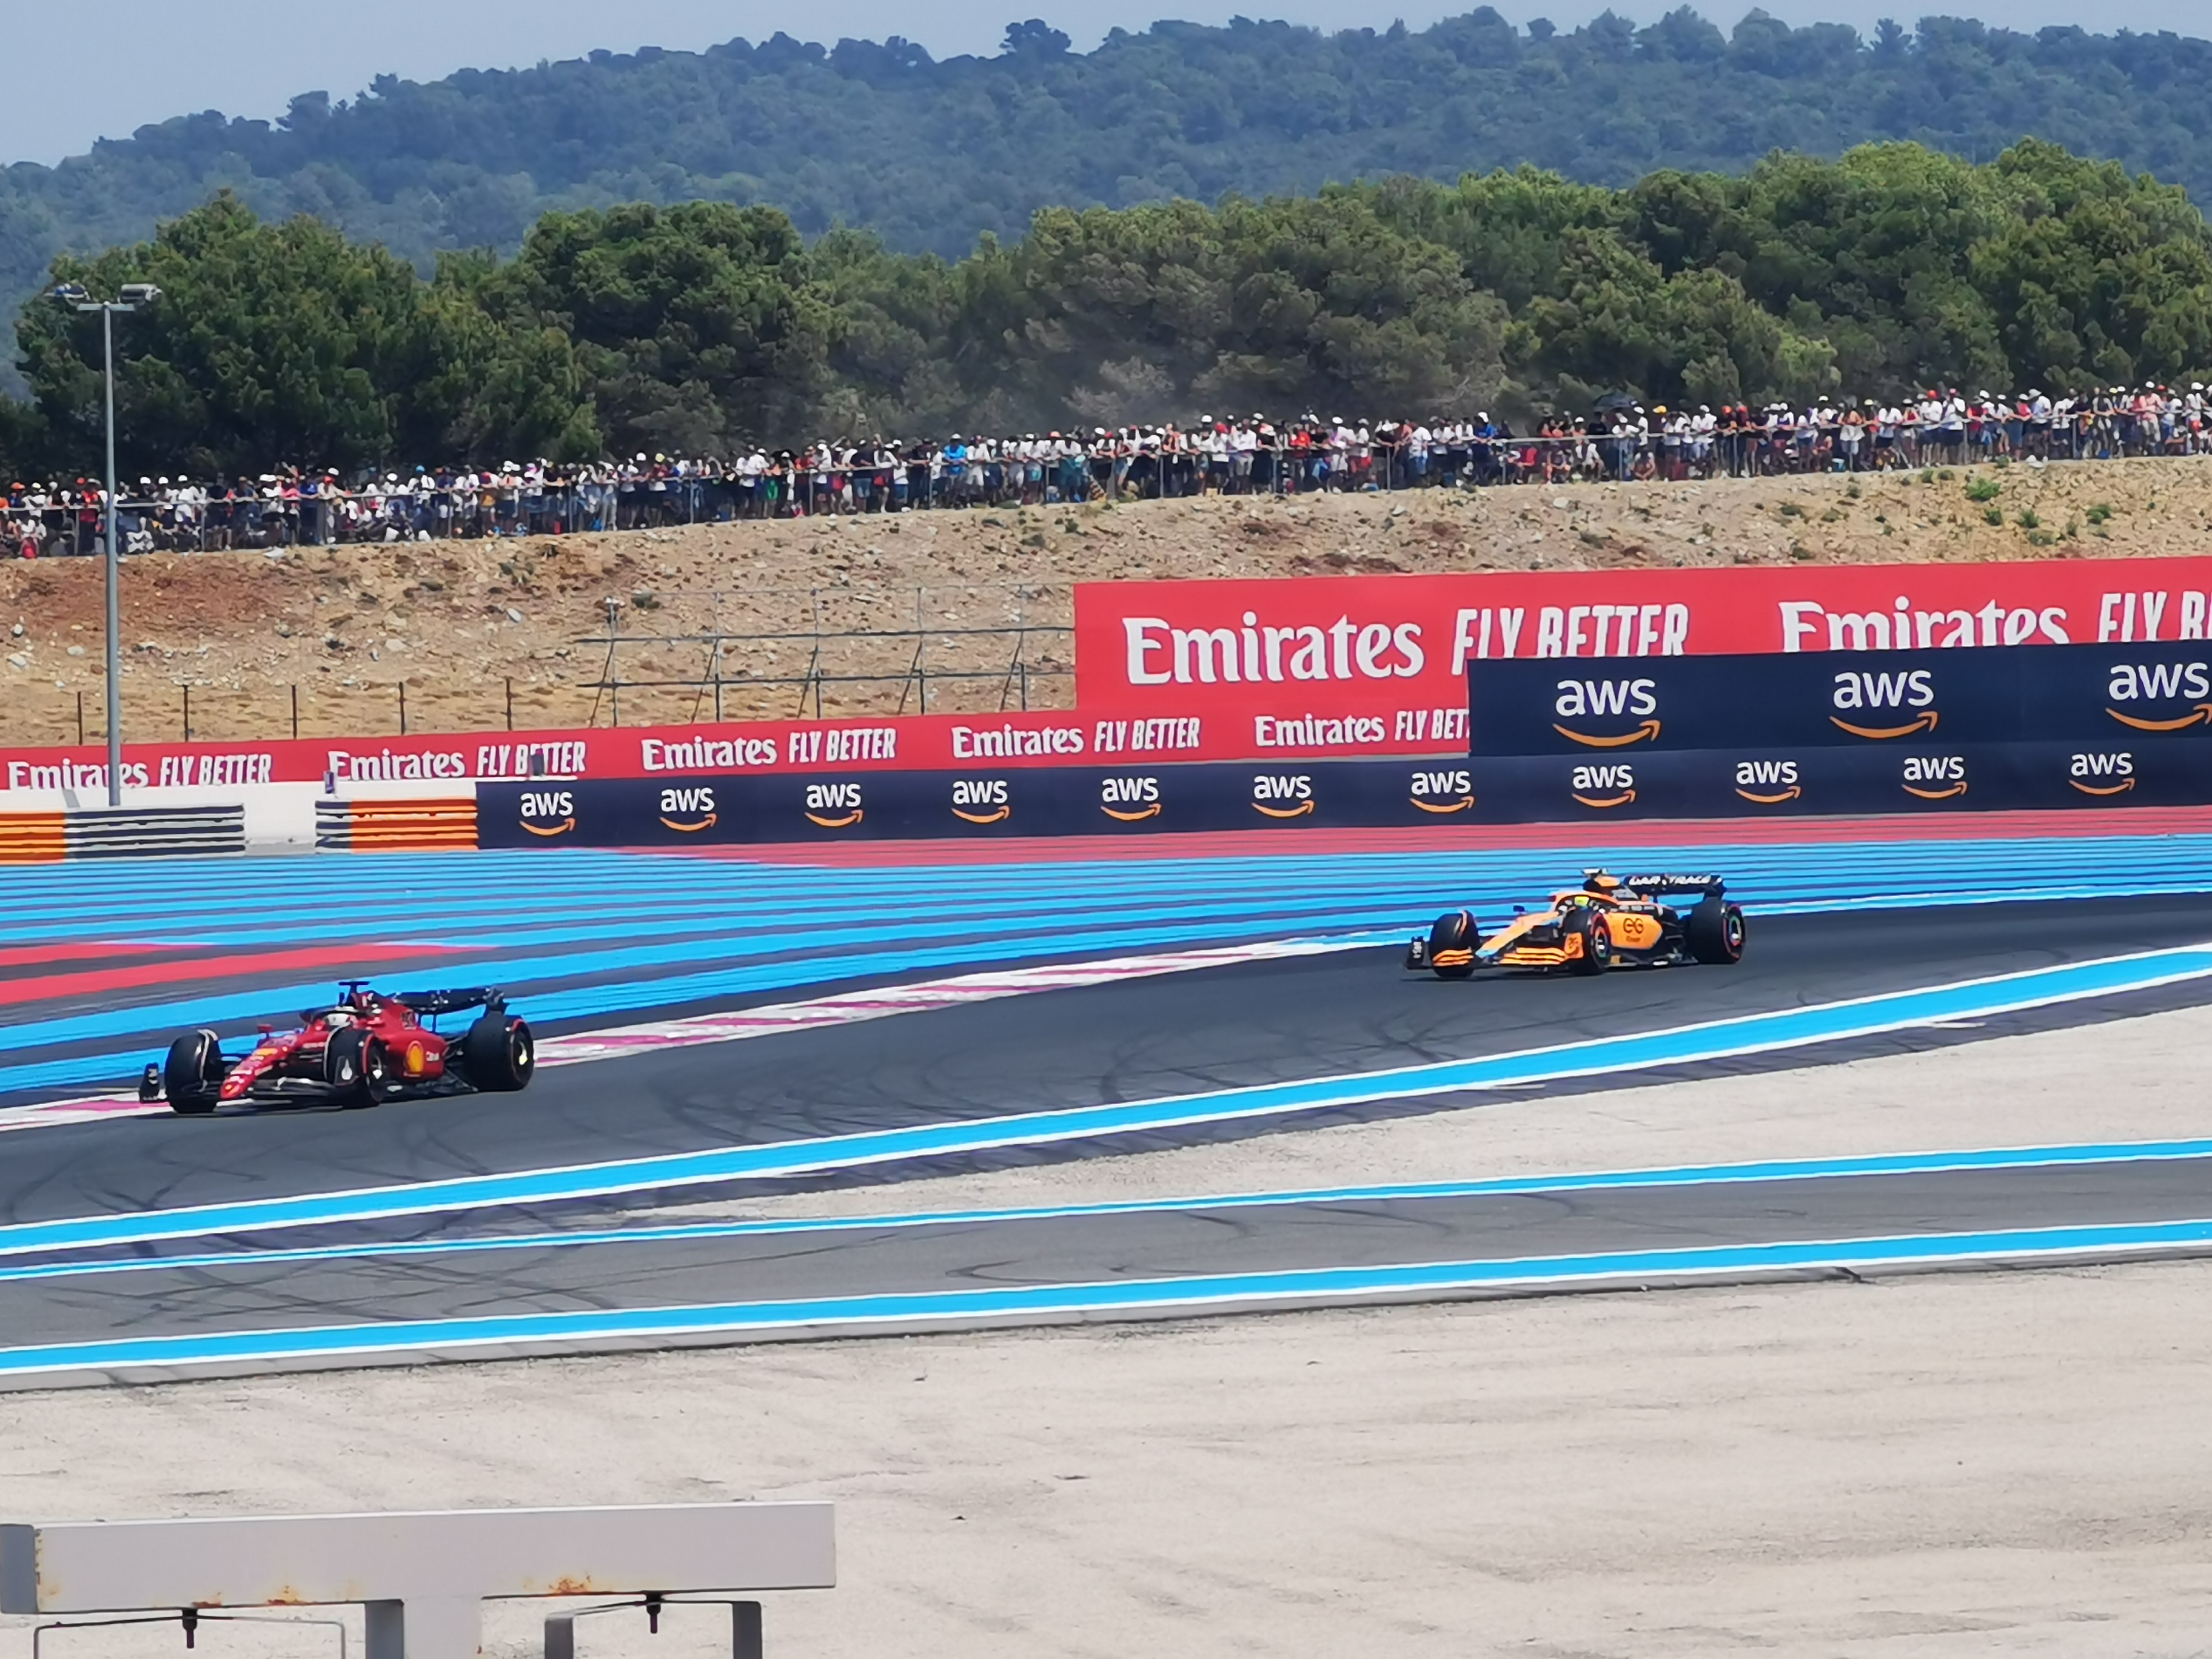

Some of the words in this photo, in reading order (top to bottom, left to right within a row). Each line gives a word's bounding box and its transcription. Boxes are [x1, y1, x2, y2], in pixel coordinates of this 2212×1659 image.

[1778, 595, 2070, 653] Emirates
[1122, 611, 1424, 685] Emirates
[1452, 607, 1524, 675] FLY
[1537, 603, 1689, 658] BETTER
[1833, 670, 1934, 709] aws
[2108, 662, 2209, 700] aws
[1555, 679, 1657, 717] aws
[951, 723, 1084, 758] Emirates
[1094, 720, 1127, 752] FLY
[1131, 717, 1200, 750] BETTER
[1255, 713, 1385, 746] Emirates
[1395, 709, 1428, 741] FLY
[641, 736, 777, 771] Emirates
[789, 731, 822, 763] FLY
[826, 728, 896, 762] BETTER
[159, 756, 194, 787] FLY
[199, 753, 272, 785] BETTER
[328, 748, 465, 781] Emirates
[477, 745, 511, 776] FLY
[1736, 761, 1798, 785] aws
[1903, 756, 1965, 780] aws
[2071, 752, 2133, 776] aws
[1102, 777, 1159, 802] aws
[1254, 776, 1312, 799] aws
[1411, 771, 1471, 796] aws
[1573, 765, 1633, 789] aws
[520, 791, 573, 817] aws
[661, 787, 715, 812] aws
[806, 783, 861, 808] aws
[953, 780, 1008, 805] aws
